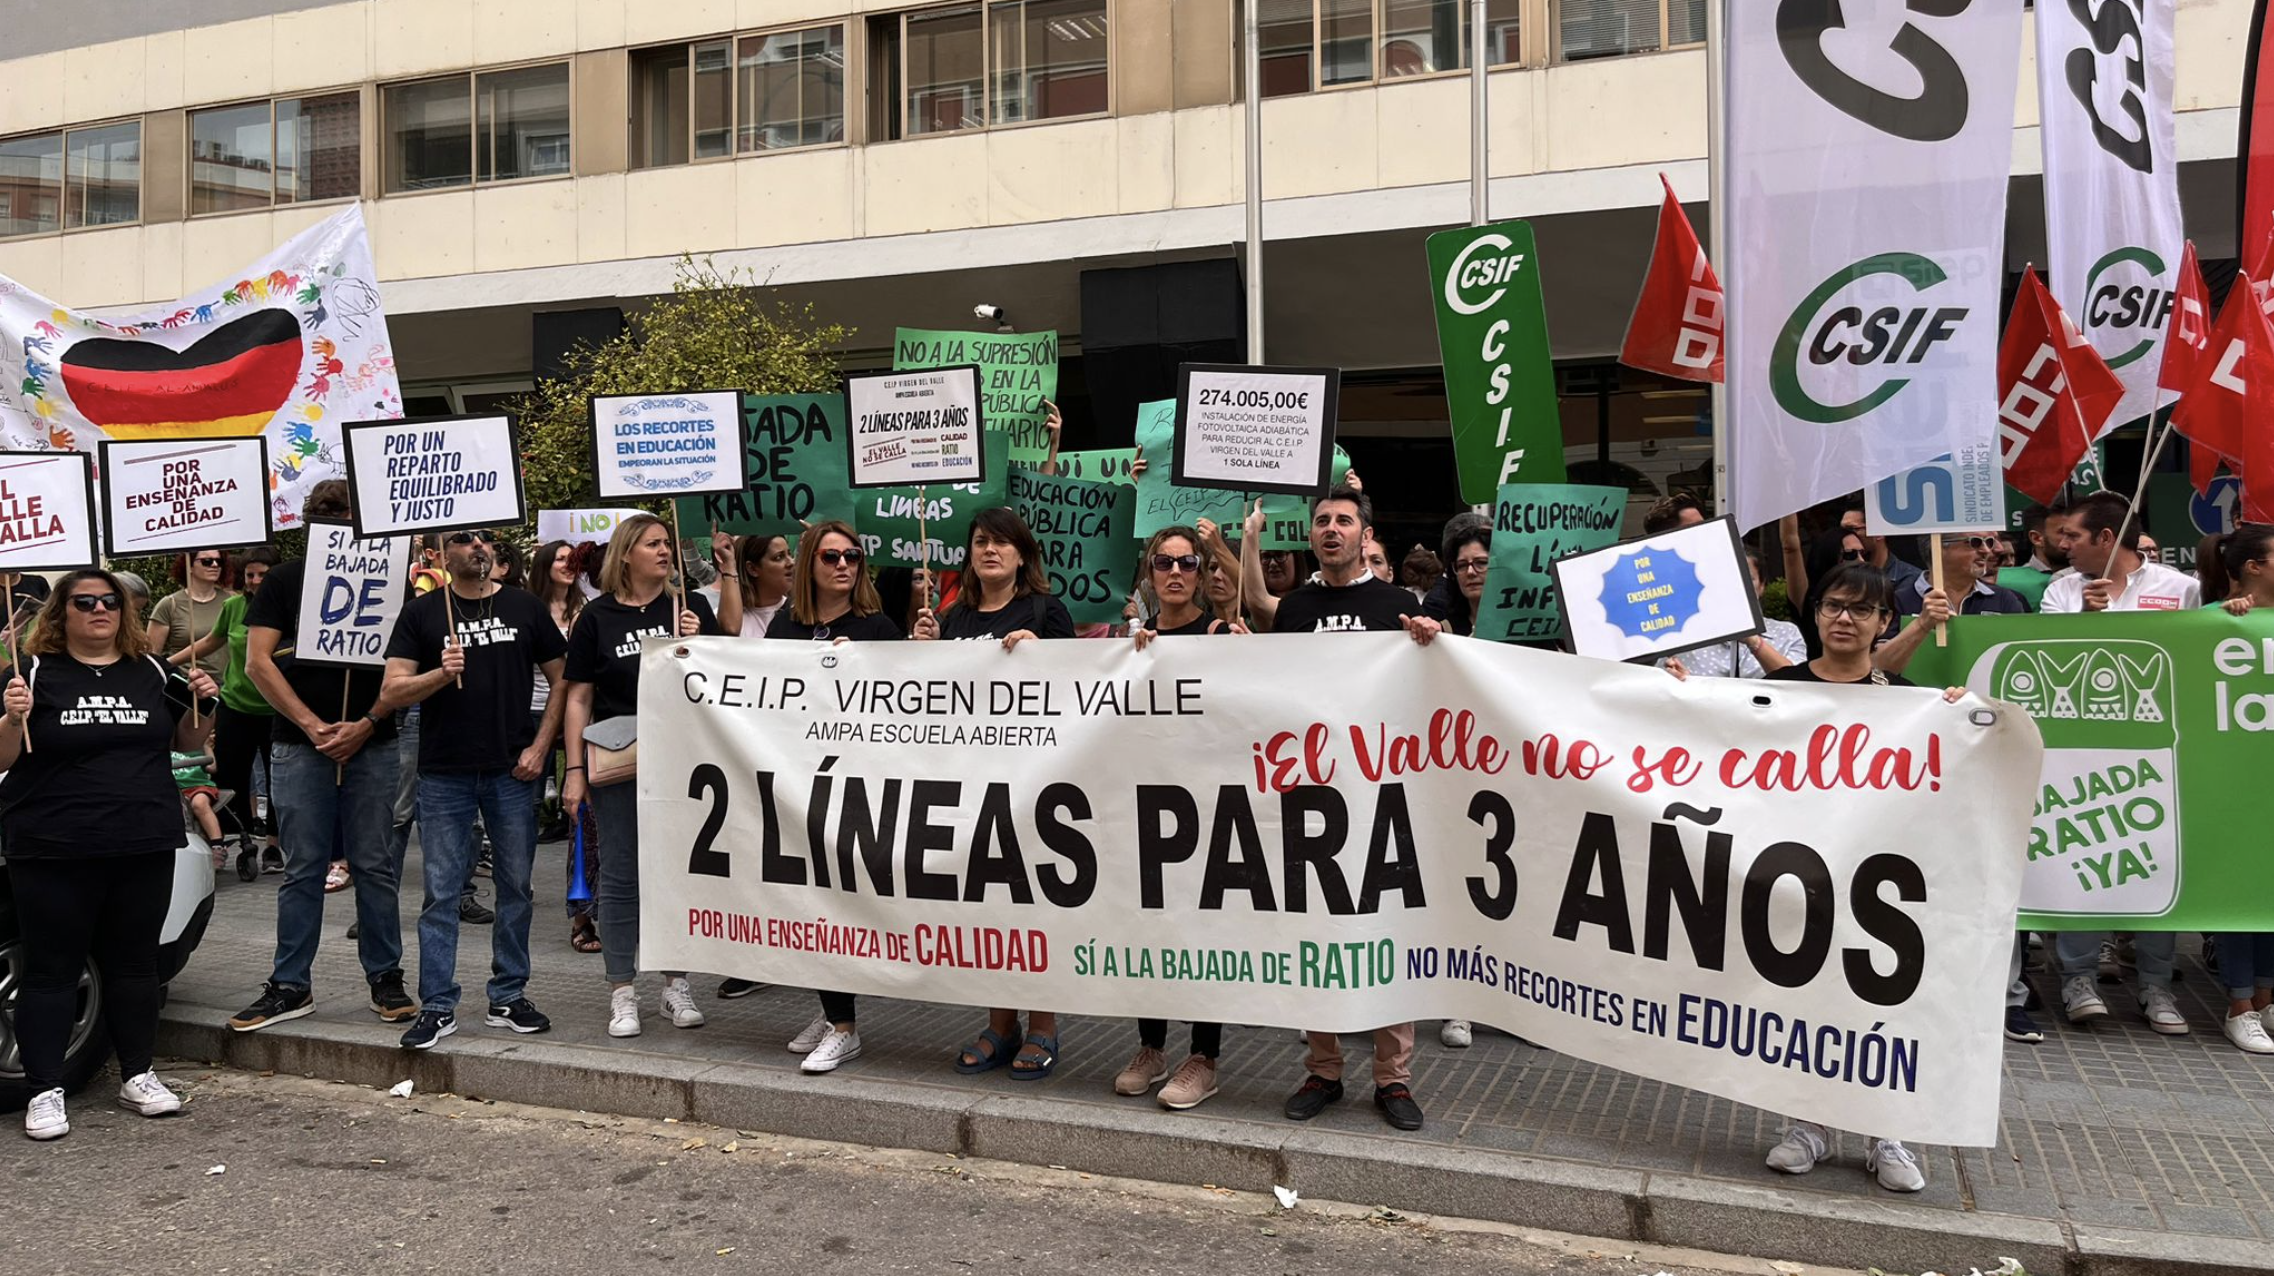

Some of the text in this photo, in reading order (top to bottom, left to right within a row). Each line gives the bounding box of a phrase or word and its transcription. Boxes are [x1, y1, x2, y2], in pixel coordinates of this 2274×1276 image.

[1459, 254, 1524, 289] CSIF
[1809, 306, 1970, 365] CSIF
[900, 335, 1058, 366] NO A LA SUPRESIÓN
[991, 369, 1041, 391] EN LA
[1199, 389, 1308, 412] 274.005,00€
[1482, 319, 1524, 490] CSIF
[615, 419, 714, 436] LOS RECORTES
[860, 404, 969, 433] 2 LÍNEAS PARA 3 AÑOS
[1198, 423, 1309, 436] FOTOVOLTAICA ADIABÁTICA
[1202, 412, 1307, 424] INSTALACIÓN DE ENERGÍA
[384, 431, 445, 455] POR UN
[616, 435, 716, 455] EN EDUCACIÓN
[879, 443, 900, 454] VALLE
[941, 433, 968, 442] CALIDAD
[941, 444, 959, 455] RATIO
[1202, 434, 1224, 443] PARA
[1225, 435, 1262, 445] REDUCIR
[1263, 438, 1274, 446] AL
[618, 454, 716, 468] EMPEORAN LA SITUACIÓN
[748, 446, 798, 482] DE
[884, 448, 906, 459] CALLA
[942, 455, 973, 467] EDUCACIÓN
[1210, 446, 1241, 455] VIRGEN
[1242, 448, 1258, 456] DEL
[1261, 449, 1285, 458] VALLE
[163, 459, 200, 476] POR
[386, 452, 462, 478] REPARTO
[1230, 459, 1252, 468] SOLA
[1255, 459, 1280, 470] LÍNEA
[163, 472, 202, 489] UNA
[389, 471, 497, 501] EQUILIBRADO
[1009, 475, 1117, 510] EDUCACIÓN
[1977, 451, 1993, 522] DE EMPLEADOS
[0, 495, 43, 523] LLE
[172, 498, 196, 514] DE
[391, 497, 454, 523] Y JUSTO
[1148, 499, 1169, 514] EL
[1962, 474, 1977, 523] SINDICATO
[0, 515, 65, 545] ALLA
[145, 506, 224, 532] CALIDAD
[1019, 503, 1110, 539] PÚBLICA
[325, 553, 390, 577] BAJADA
[1038, 540, 1082, 570] ARA
[1633, 556, 1651, 570] POR
[2161, 547, 2196, 563] EN
[1637, 571, 1655, 584] UNA
[320, 574, 389, 628] DE
[1626, 584, 1674, 604] ENSEÑANZA
[1648, 603, 1660, 616] DE
[1640, 615, 1676, 633] CALIDAD
[316, 629, 383, 657] RATIO
[77, 696, 132, 708] A.M.P.A.
[684, 671, 1204, 717] C.E.I.P. VIRGEN DEL VALLE
[806, 722, 1057, 746] AMPA ESCUELA ABIERTA
[1349, 707, 1509, 783] Valle
[1523, 732, 1615, 782] no
[1626, 745, 1702, 793] se
[1719, 722, 1941, 792] calla!
[2027, 796, 2165, 862] RATIO
[2071, 841, 2158, 892] ¡YA!
[688, 755, 1927, 1006] 2 LÍNEAS PARA 3 AÑOS
[689, 908, 1049, 974] POR UNA ENSEÑANZA DE CALIDAD
[1074, 937, 1395, 990] SÍ A LA BAJADA DE RATIO
[1407, 944, 1919, 1093] NO MÁS RECORTES EN EDUCACIÓN
